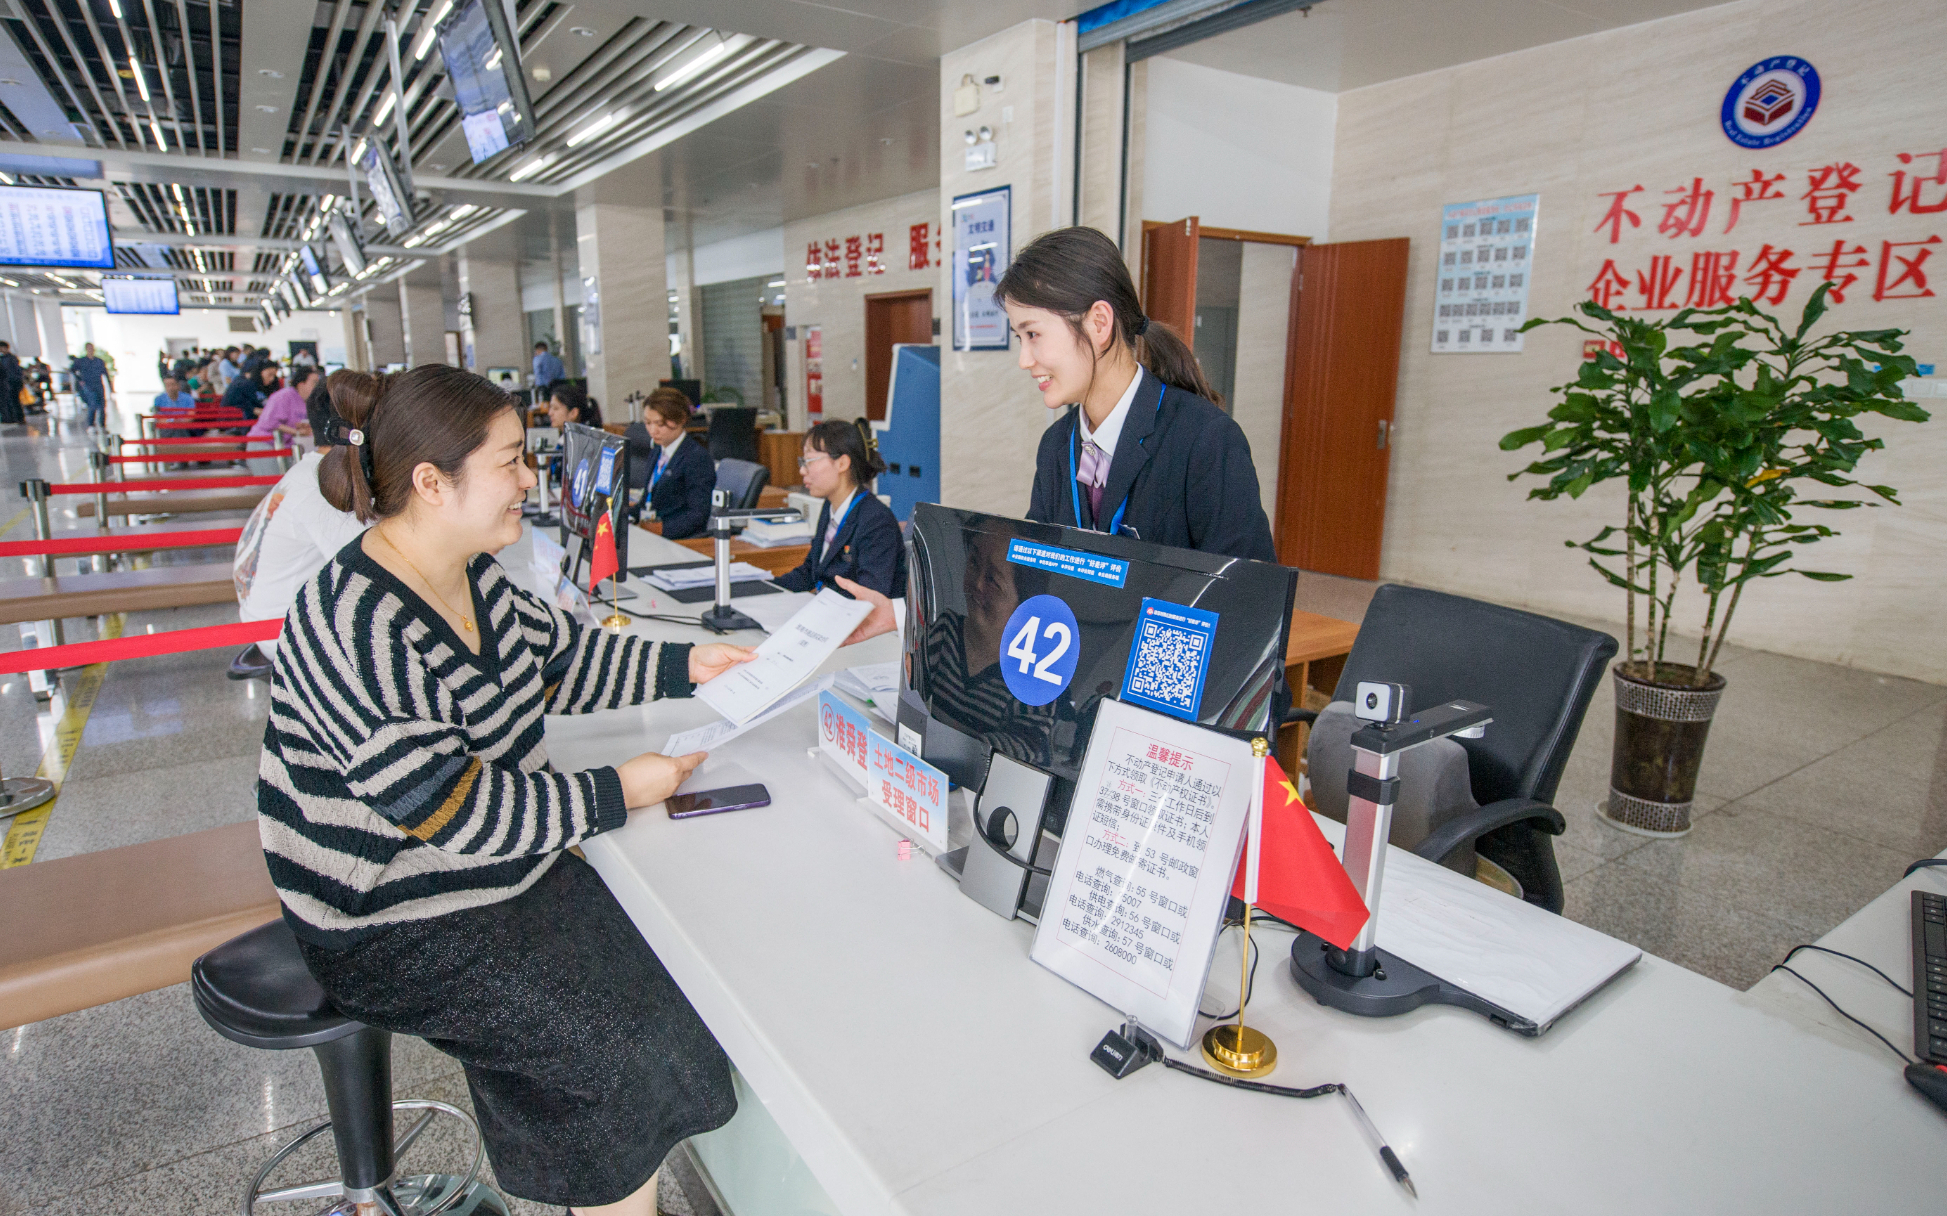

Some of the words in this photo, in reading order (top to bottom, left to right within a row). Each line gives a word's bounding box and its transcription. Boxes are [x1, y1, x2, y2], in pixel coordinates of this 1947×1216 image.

[1594, 148, 1947, 244] 不动产登记
[806, 232, 886, 282] 依法登记
[909, 222, 941, 270] 服
[1586, 234, 1943, 312] 企业服务专区
[573, 468, 588, 495] 41
[1007, 616, 1071, 686] 42
[836, 713, 868, 771] 淮舜登
[1145, 743, 1194, 771] 温馨提示
[874, 743, 940, 806] 土地二级市场
[1125, 753, 1222, 798] 不动产登记申请人通过以
[882, 779, 930, 832] 受理窗口
[1092, 810, 1120, 832] 证短信；
[1095, 797, 1208, 853] 需携带身份证件及手机领
[1075, 870, 1142, 909] 电话查询：5007
